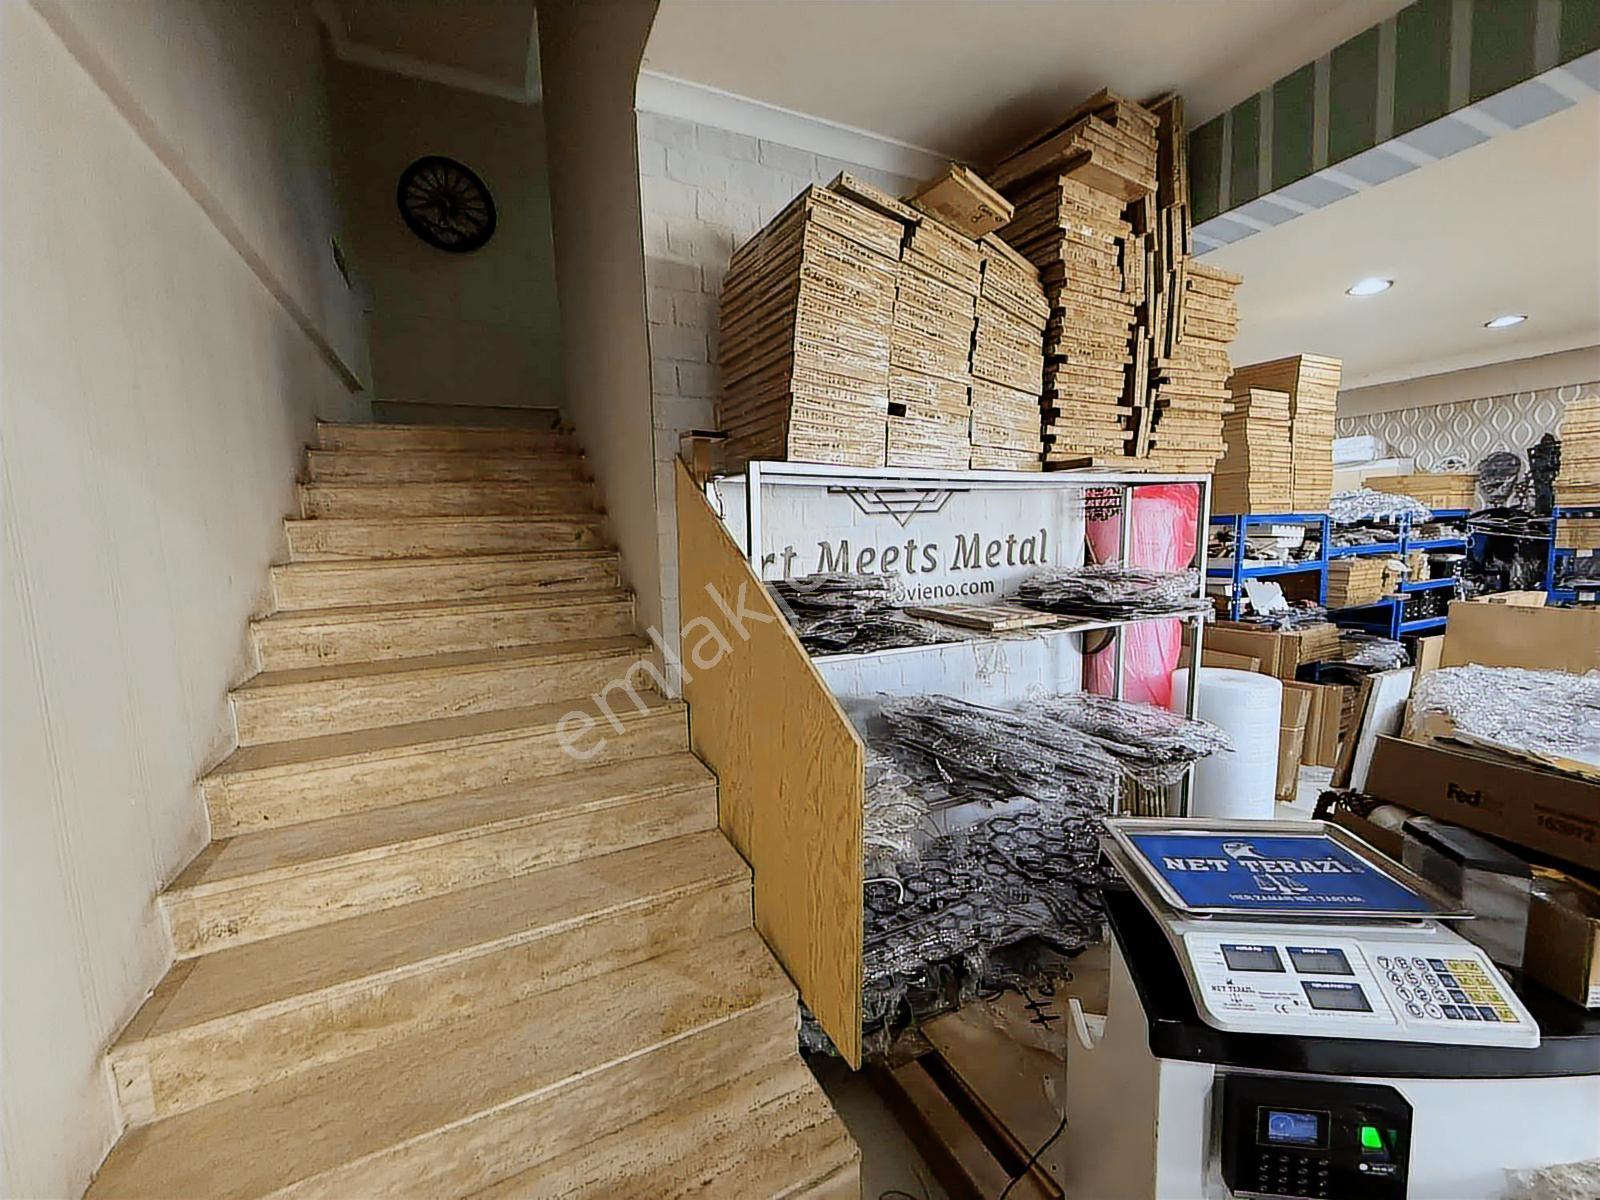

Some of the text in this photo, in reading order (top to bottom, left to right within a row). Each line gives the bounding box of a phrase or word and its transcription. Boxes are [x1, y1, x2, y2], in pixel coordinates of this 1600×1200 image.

[761, 528, 1047, 580] rt Meets Metal
[1163, 856, 1229, 872] NET
